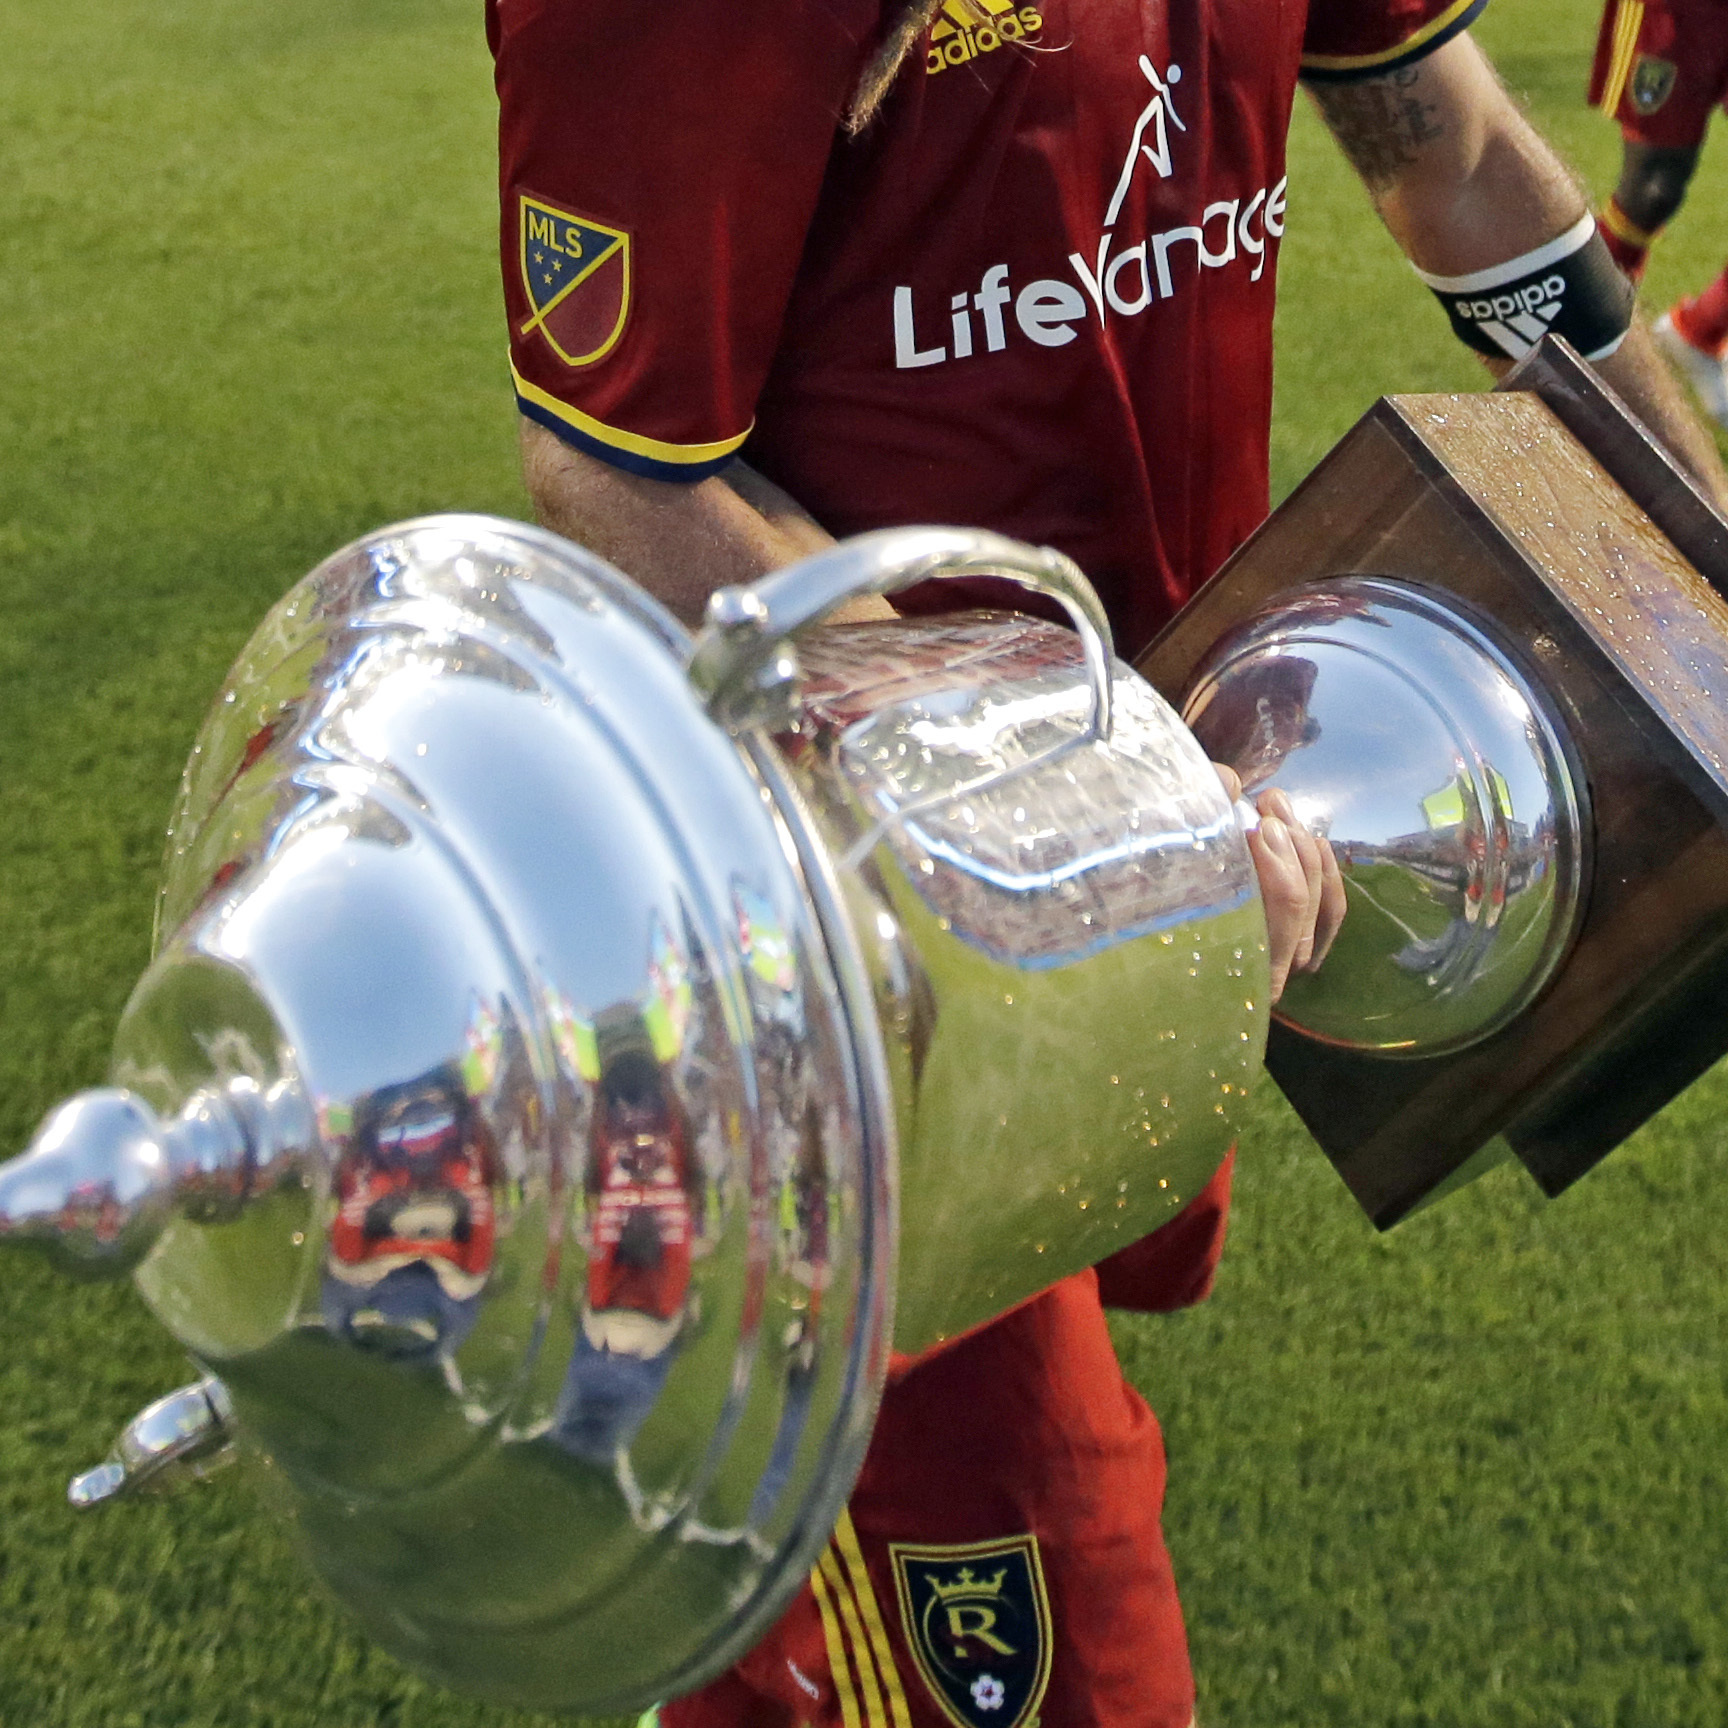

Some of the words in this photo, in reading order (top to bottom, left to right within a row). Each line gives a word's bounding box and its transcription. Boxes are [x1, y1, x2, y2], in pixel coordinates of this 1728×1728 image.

[925, 7, 1043, 74] adidas
[529, 210, 583, 258] MLS
[893, 175, 1287, 369] LifeVanage
[1455, 274, 1566, 321] adidas
